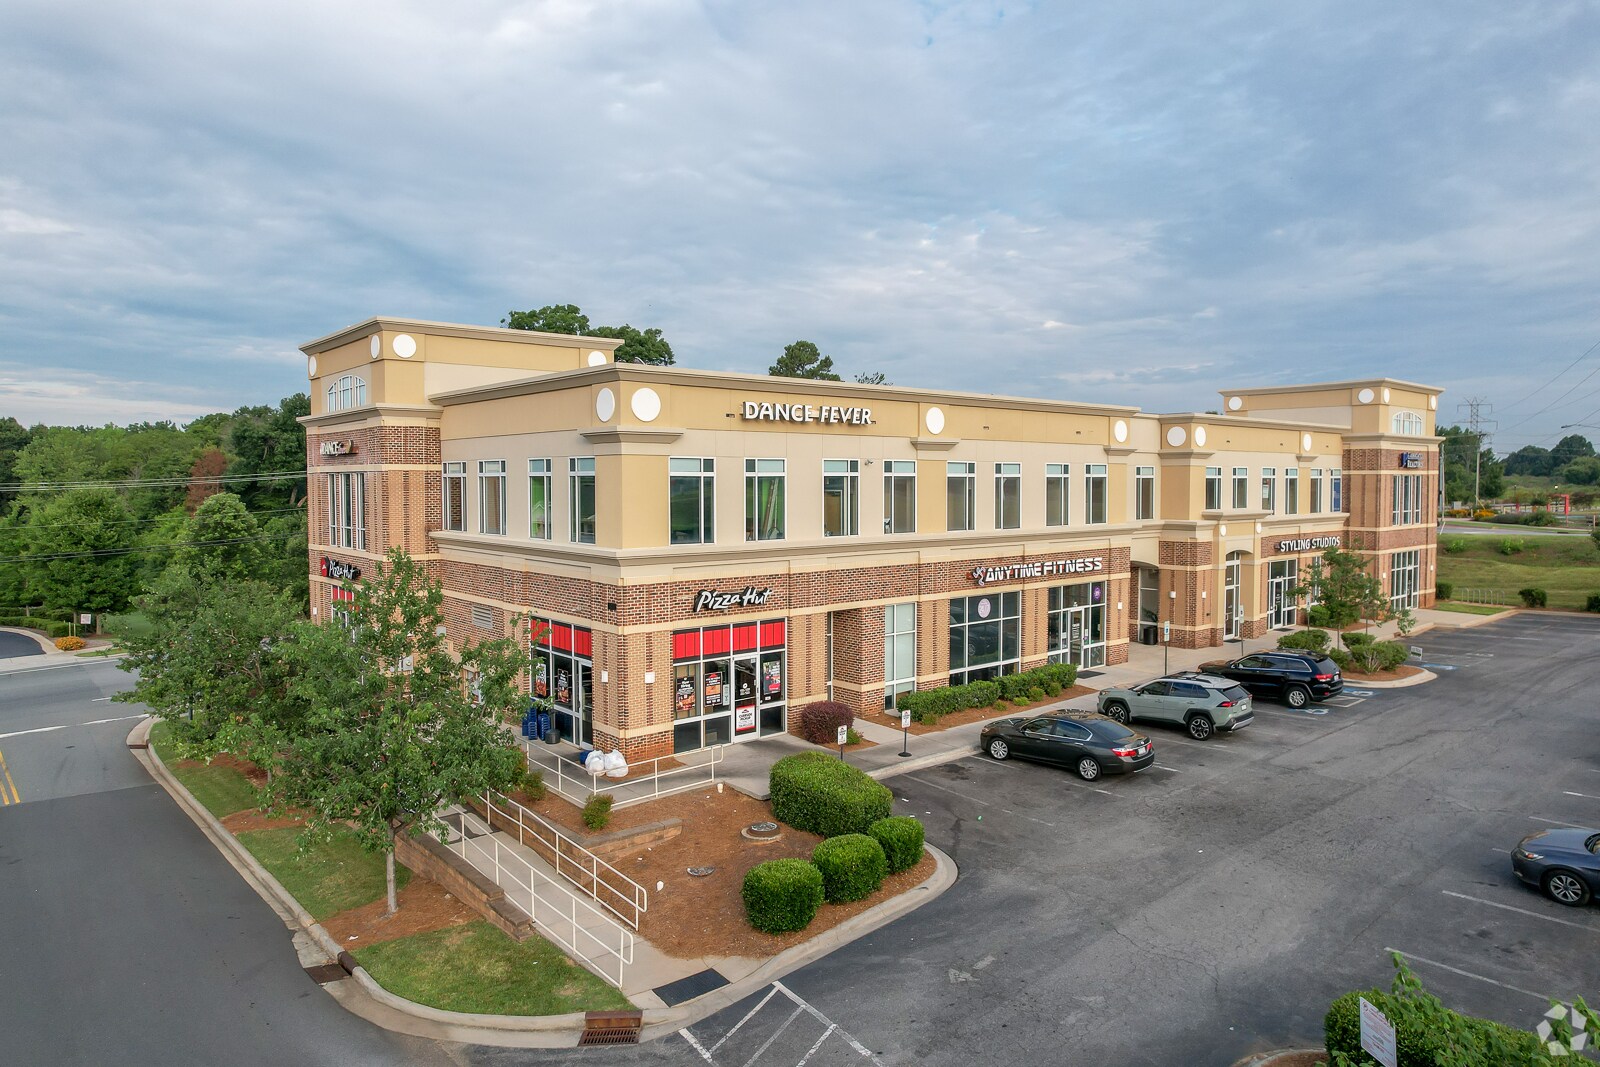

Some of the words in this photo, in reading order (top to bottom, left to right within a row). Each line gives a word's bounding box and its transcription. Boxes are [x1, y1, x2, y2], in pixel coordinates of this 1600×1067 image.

[744, 401, 813, 422] DANCE
[820, 405, 872, 425] FEVER
[1280, 539, 1311, 552] STYLING
[1311, 536, 1341, 549] STUDIOS
[343, 563, 355, 579] Hut
[985, 563, 1041, 582] ANYTIME
[1043, 557, 1103, 576] FITNESS
[696, 590, 741, 613] Pizza
[742, 587, 773, 607] Hut
